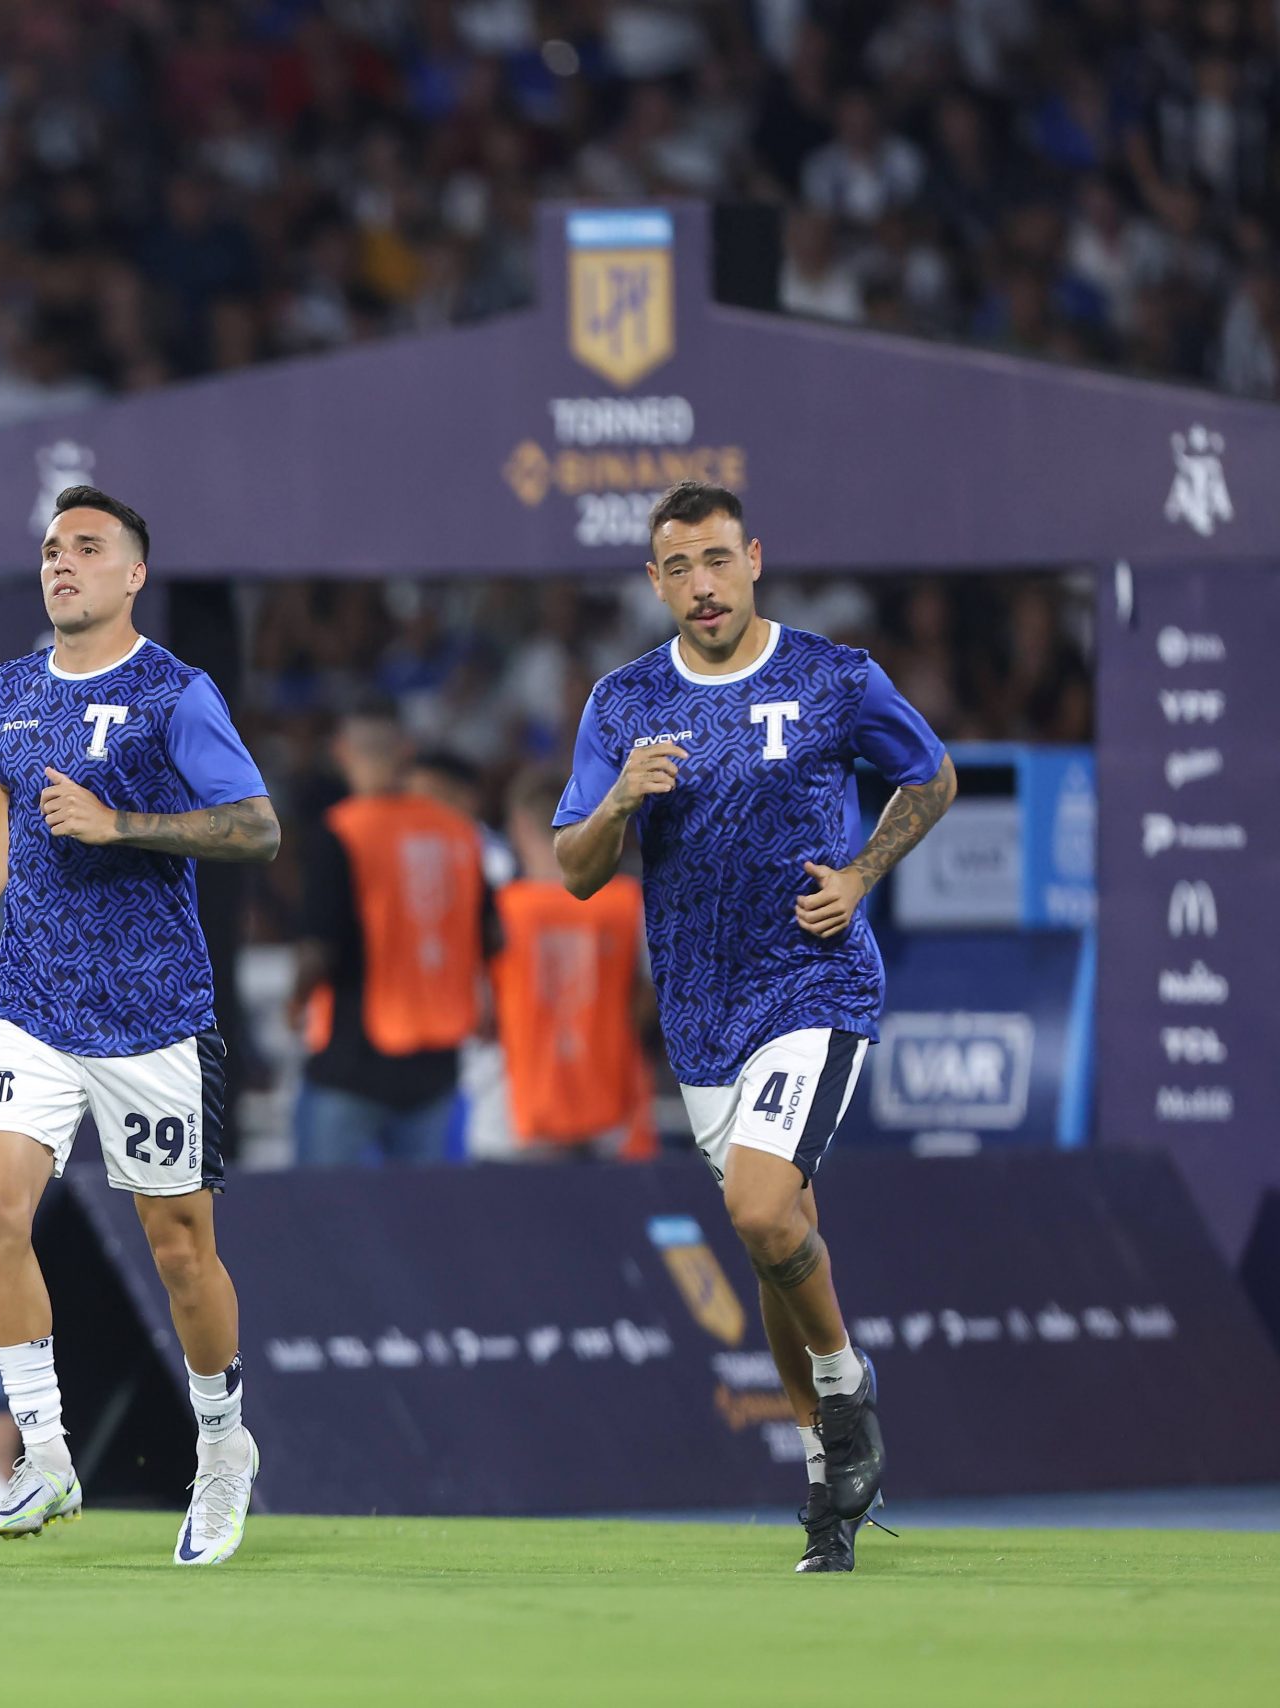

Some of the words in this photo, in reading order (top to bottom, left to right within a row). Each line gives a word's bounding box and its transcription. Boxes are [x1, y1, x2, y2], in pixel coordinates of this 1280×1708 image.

[553, 398, 695, 444] TORNEO
[575, 494, 655, 545] 202
[83, 703, 129, 762] T
[750, 701, 800, 760] T
[1160, 690, 1225, 723] YPF
[634, 730, 693, 748] GIVOVA
[753, 1071, 789, 1122] 4
[901, 1039, 1005, 1100] VAR
[782, 1074, 807, 1131] GIVOVA
[124, 1112, 184, 1166] 29
[188, 1112, 196, 1169] GIVOVA
